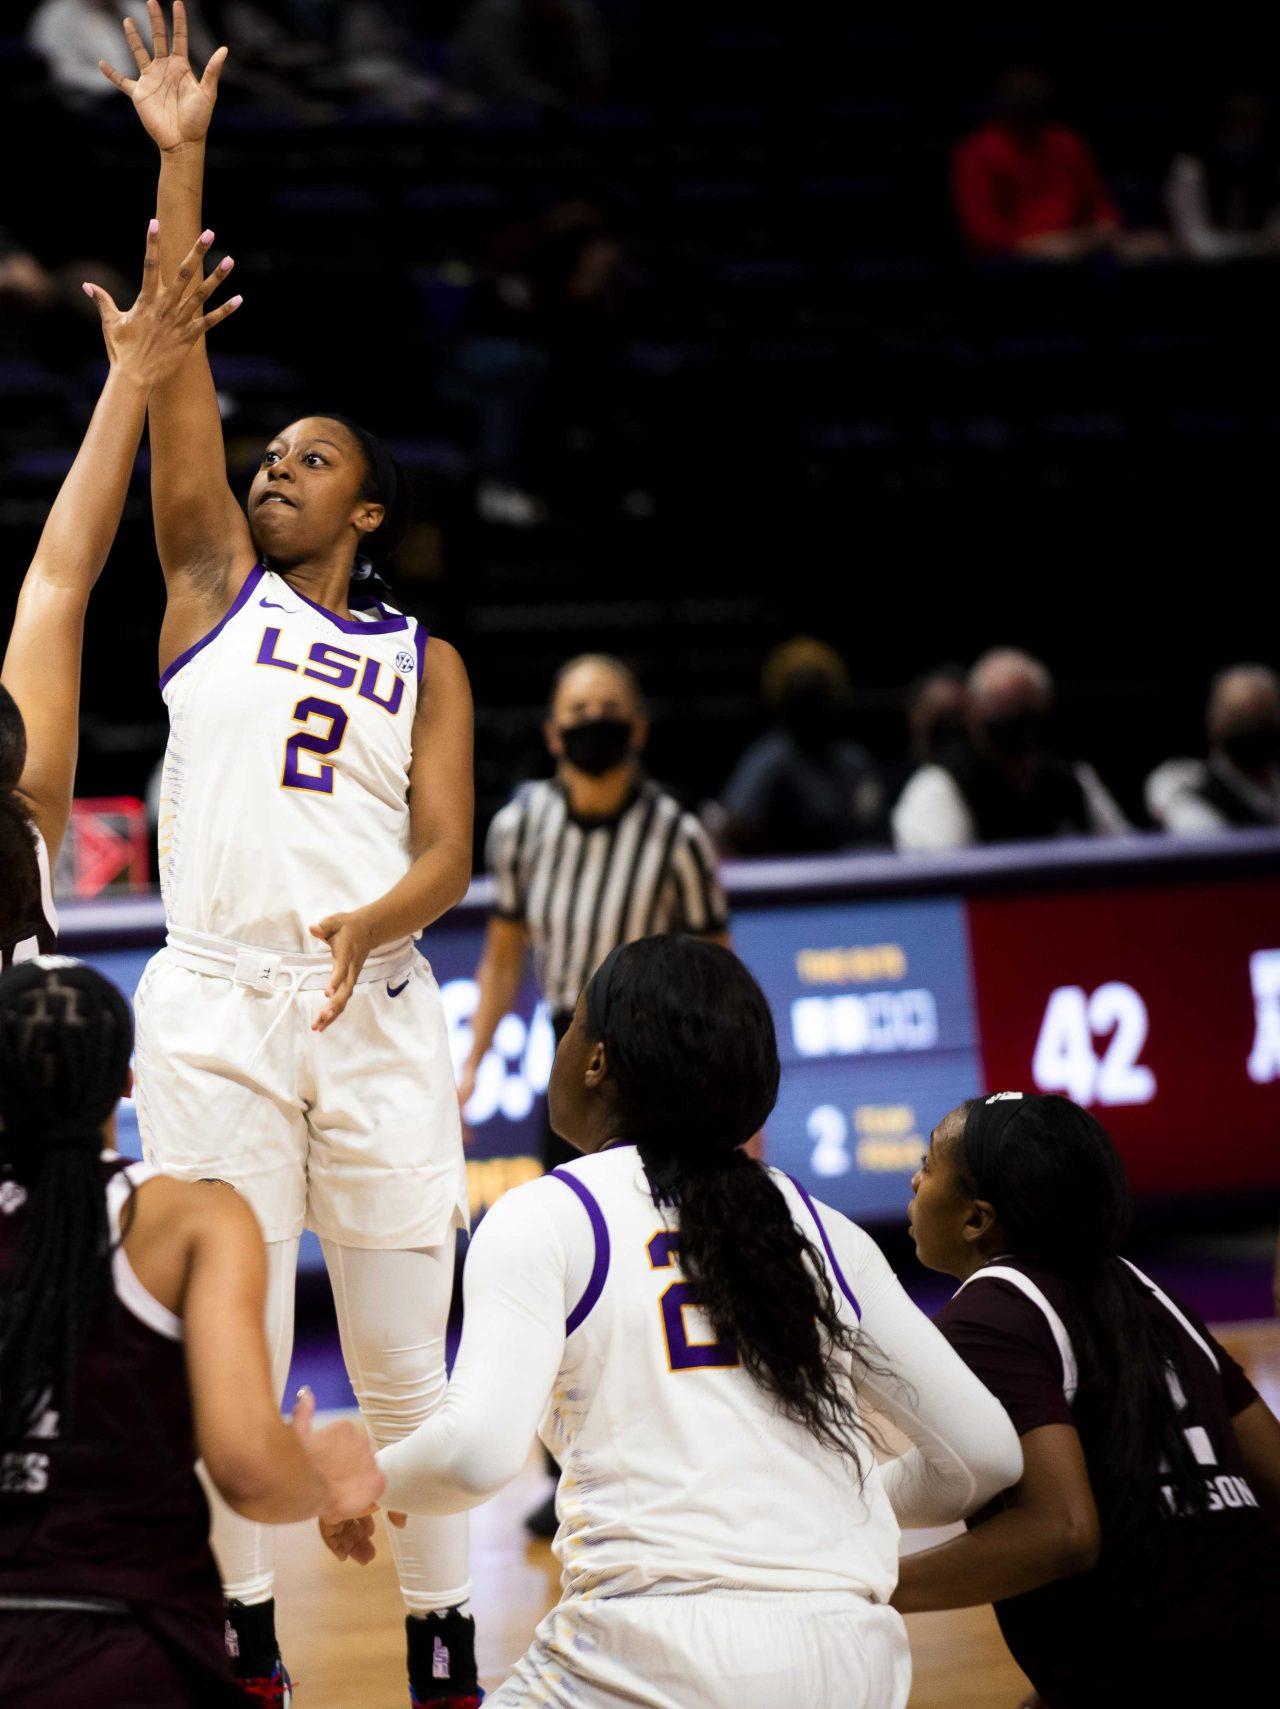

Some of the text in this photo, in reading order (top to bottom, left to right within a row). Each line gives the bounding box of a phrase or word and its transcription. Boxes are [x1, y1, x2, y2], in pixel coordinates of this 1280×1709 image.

[256, 626, 405, 717] LSU
[280, 696, 349, 796] 2
[1032, 980, 1157, 1108] 42
[807, 1105, 851, 1178] 2
